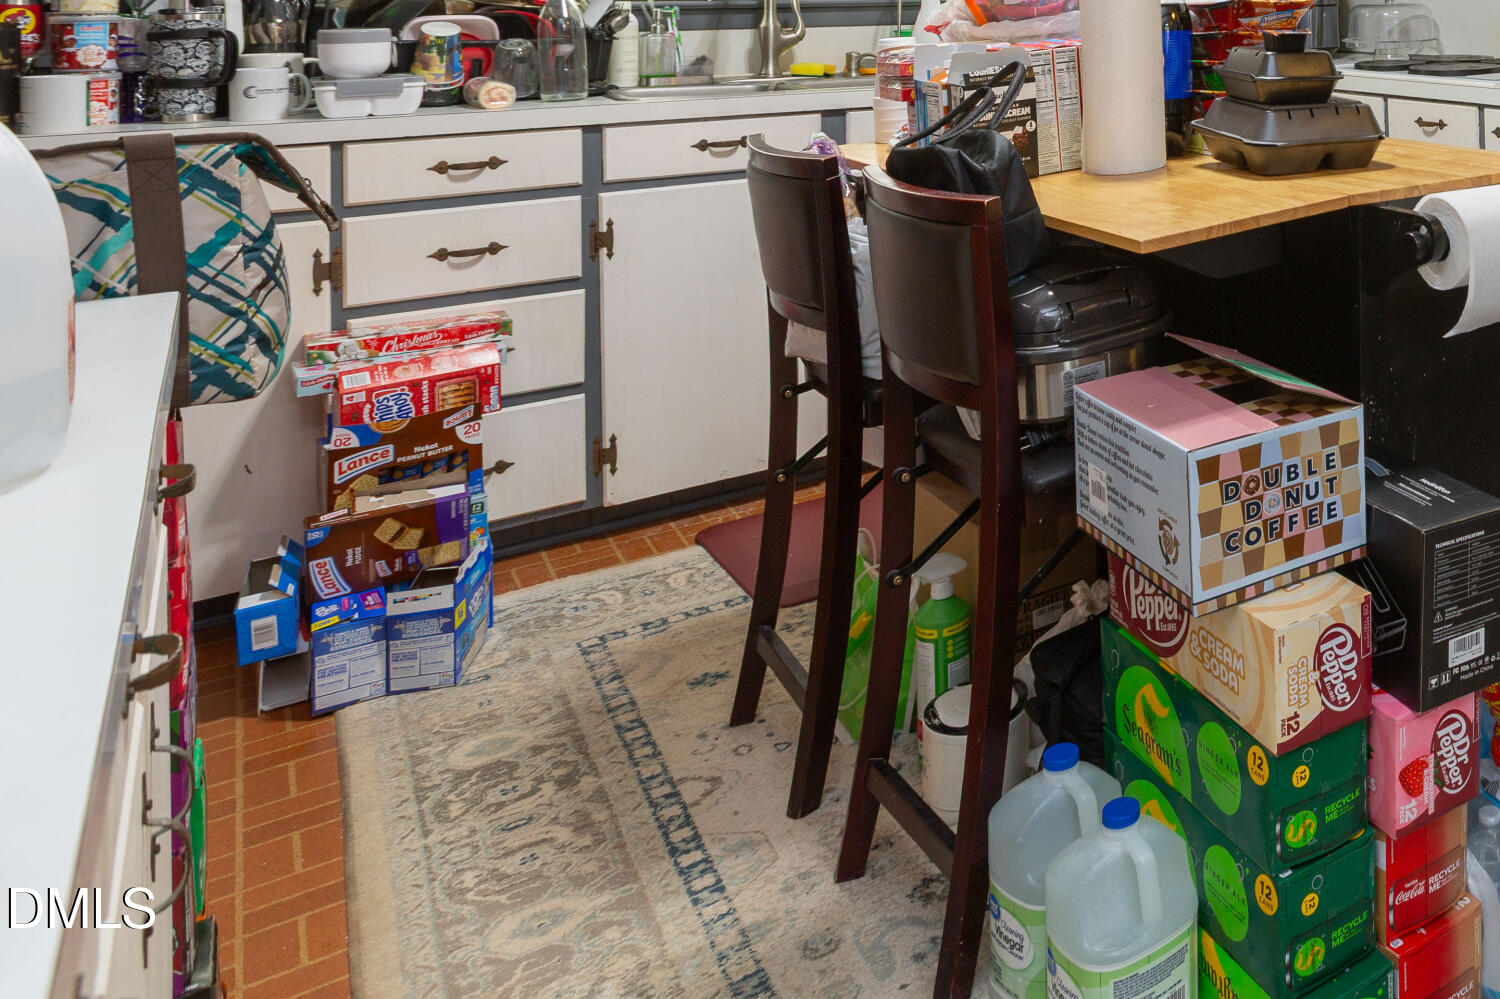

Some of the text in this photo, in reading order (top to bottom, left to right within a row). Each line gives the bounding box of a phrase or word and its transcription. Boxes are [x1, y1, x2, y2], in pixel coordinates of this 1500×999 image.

[381, 329, 443, 353] Christmas
[375, 396, 390, 423] hips
[463, 422, 481, 436] 20
[333, 438, 352, 448] 20
[397, 445, 454, 463] PEANUT BUTTER
[413, 443, 438, 453] Nekot
[337, 449, 390, 476] Lance
[1223, 451, 1337, 503] DOUBLE
[1244, 475, 1338, 522] DONUT
[1224, 500, 1338, 553] COFFEE
[315, 560, 341, 599] Lance
[1129, 568, 1178, 632] Pepper
[1190, 632, 1201, 656] &
[1200, 628, 1245, 678] CREAM
[1203, 651, 1239, 692] SODA
[1297, 657, 1309, 708] CREAM
[1309, 672, 1319, 685] &
[1319, 635, 1351, 704] Pepper
[1460, 671, 1474, 681] Made
[1480, 664, 1494, 673] China
[1288, 667, 1298, 706] SODA
[1287, 711, 1300, 736] 12
[1122, 703, 1182, 777] Seagram's
[1436, 721, 1463, 786] Pepper
[1453, 735, 1470, 765] Dr
[1199, 741, 1239, 778] GINGER ALE
[1252, 751, 1264, 772] 12
[1250, 767, 1265, 782] CANS
[1299, 768, 1307, 782] 12
[1324, 787, 1361, 815] RECYCLE
[1405, 798, 1417, 823] 12
[1325, 812, 1339, 824] ME
[1205, 862, 1246, 905] GINGER ALE
[1428, 857, 1461, 885] RECYCLE
[1260, 881, 1272, 901] 12
[1428, 882, 1441, 894] ME
[1258, 896, 1274, 912] CANS
[1308, 897, 1316, 910] 12
[995, 922, 1025, 953] Vinegar
[1000, 919, 1025, 944] Cleaning
[1331, 910, 1368, 939] RECYCLE
[1332, 936, 1345, 949] ME
